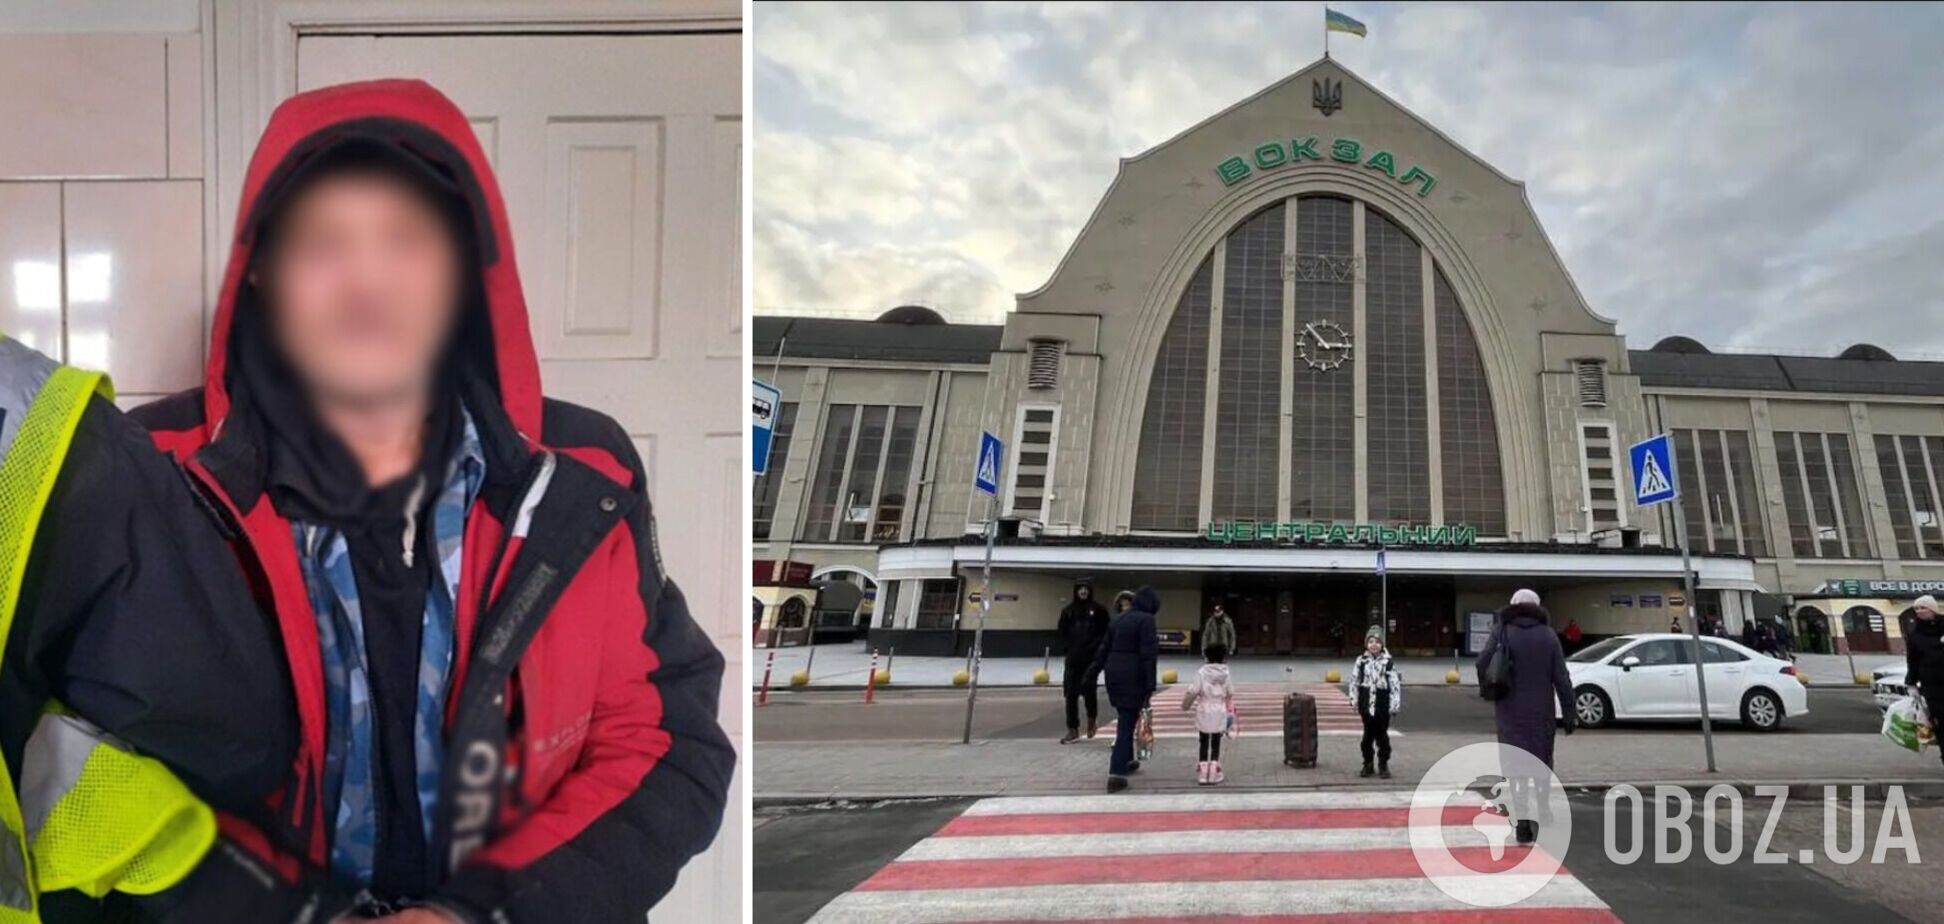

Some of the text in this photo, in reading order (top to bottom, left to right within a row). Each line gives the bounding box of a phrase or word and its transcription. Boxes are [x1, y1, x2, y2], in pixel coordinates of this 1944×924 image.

[1216, 135, 1438, 197] ВОКЗАЛ
[1207, 520, 1477, 545] ЦЕНТРАЛЬНИЙ
[1869, 581, 1897, 591] ВСЕ
[1899, 581, 1909, 592] В
